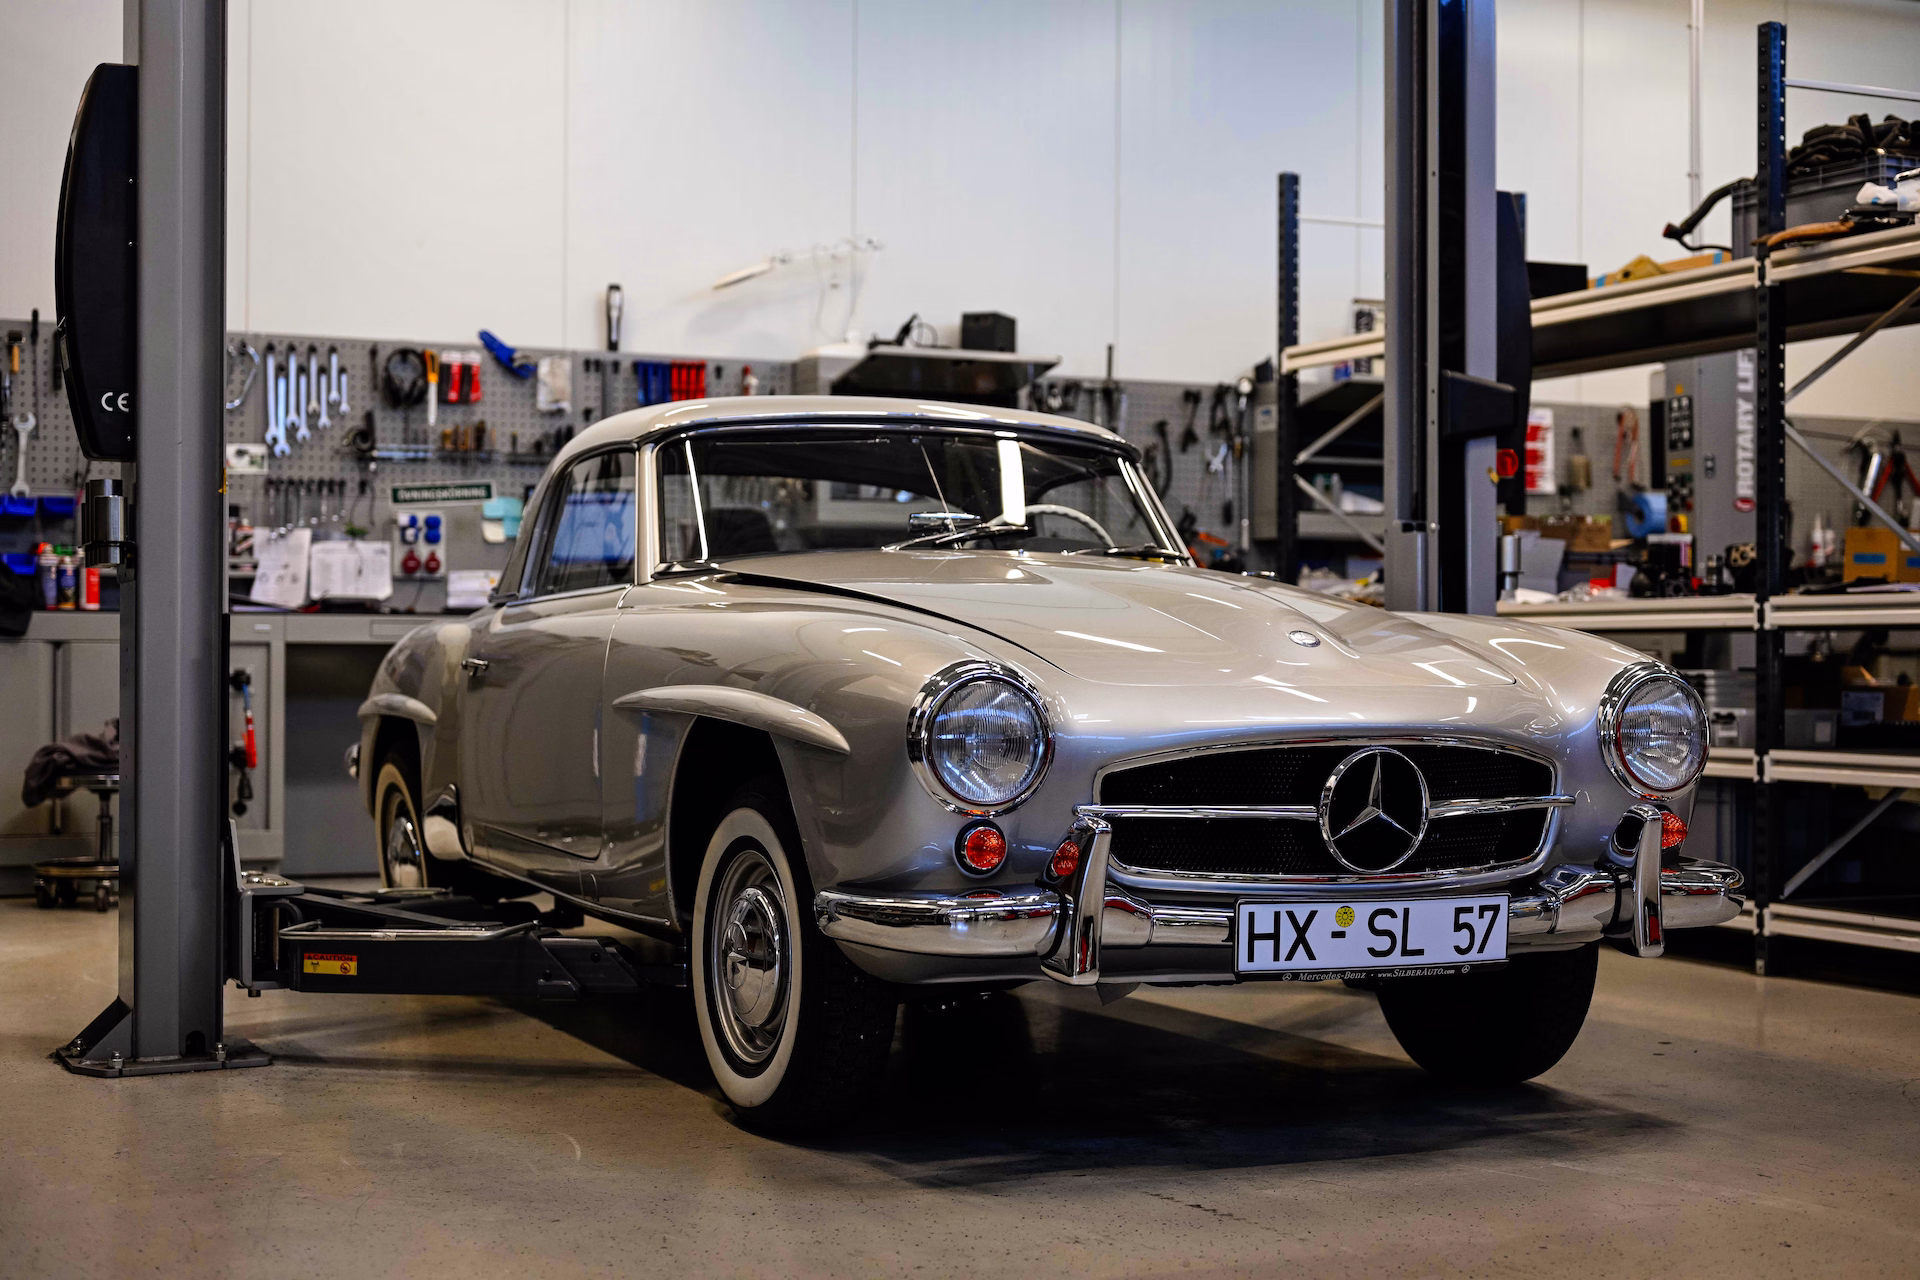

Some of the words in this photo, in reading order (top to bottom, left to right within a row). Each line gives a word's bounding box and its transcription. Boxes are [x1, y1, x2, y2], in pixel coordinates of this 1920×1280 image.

[101, 392, 129, 412] CE
[1736, 397, 1754, 497] ROTARY
[1247, 910, 1318, 962] HX
[1367, 907, 1425, 958] SL
[1453, 904, 1500, 956] 57
[312, 954, 353, 962] CAUTION
[1298, 971, 1366, 980] Mercedes-Benz
